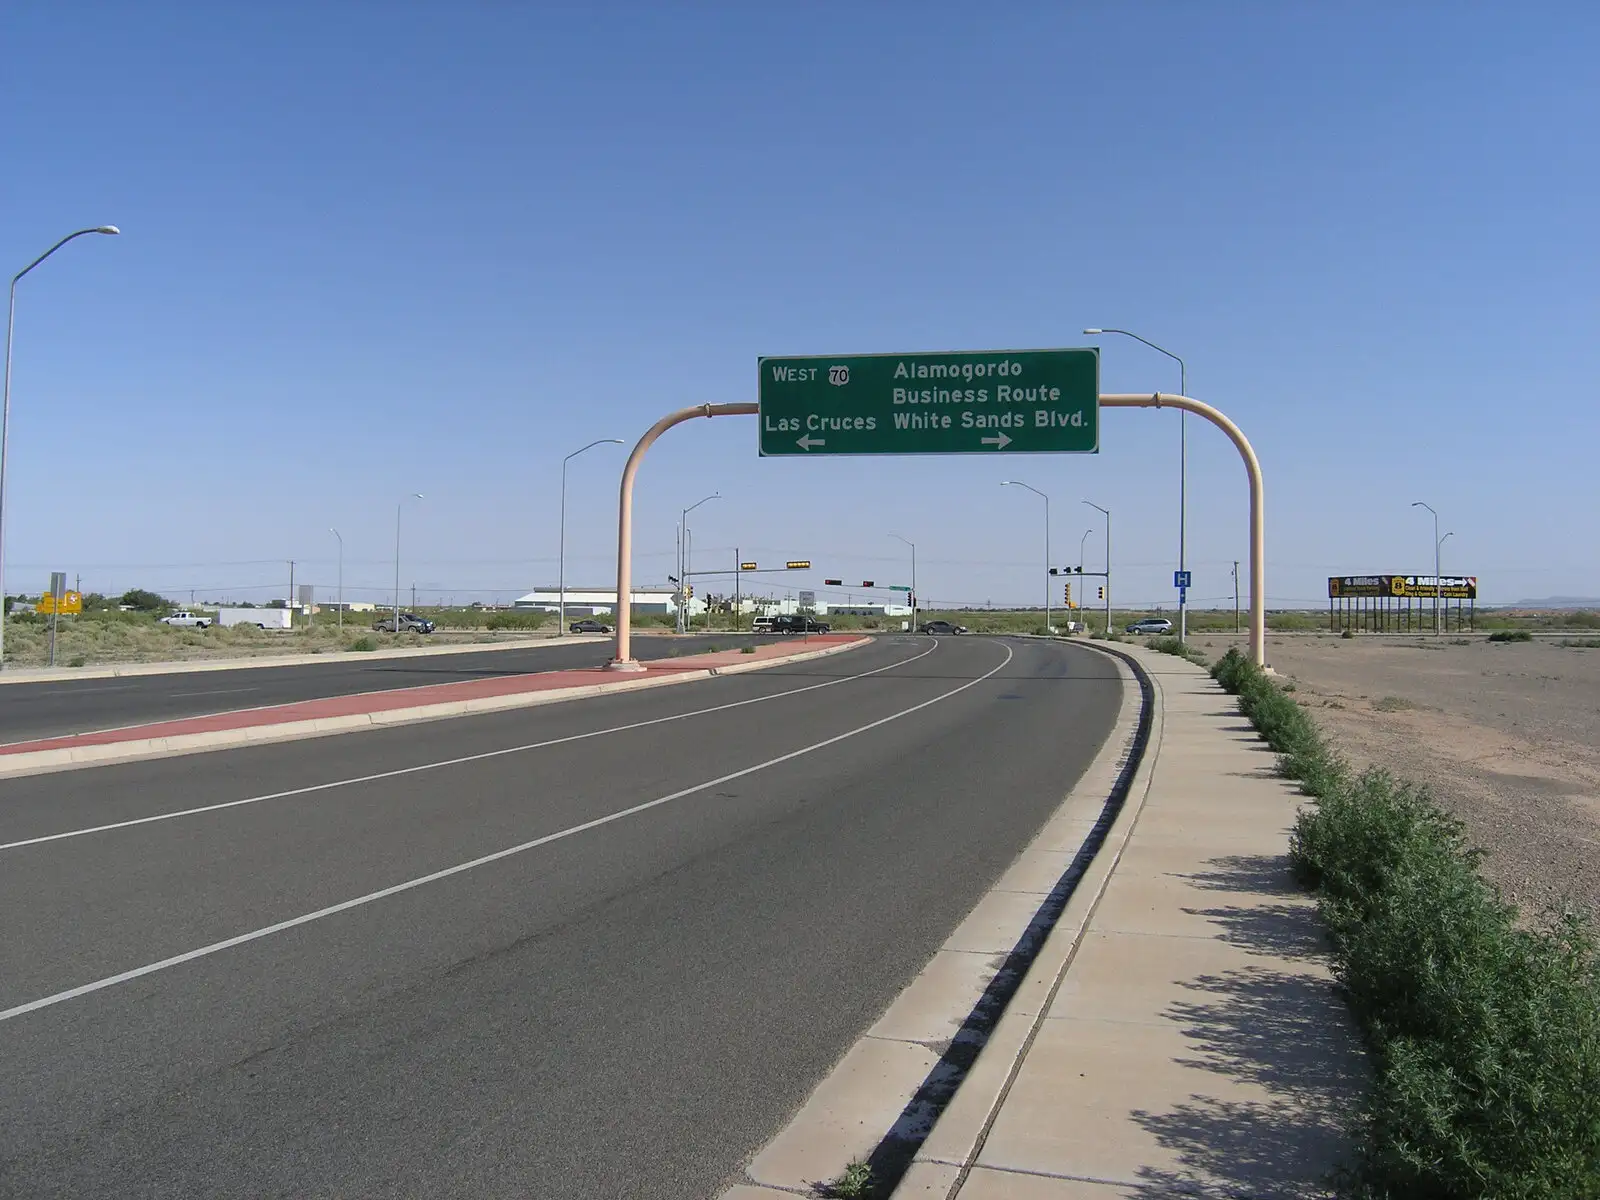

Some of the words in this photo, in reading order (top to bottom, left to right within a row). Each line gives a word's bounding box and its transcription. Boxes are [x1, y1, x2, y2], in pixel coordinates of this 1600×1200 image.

[772, 366, 818, 382] WEST
[830, 369, 848, 383] 70
[893, 362, 1022, 383] Alamogordo
[893, 386, 988, 404] Business
[997, 384, 1061, 402] Route
[765, 415, 800, 431] Las
[806, 414, 877, 431] Cruces
[893, 412, 952, 430] White
[961, 410, 1024, 428] Sands
[1035, 409, 1088, 428] Blvd.
[1177, 573, 1188, 585] H
[1353, 577, 1379, 586] Miles
[1405, 577, 1415, 585] 4
[1417, 576, 1455, 586] Miles
